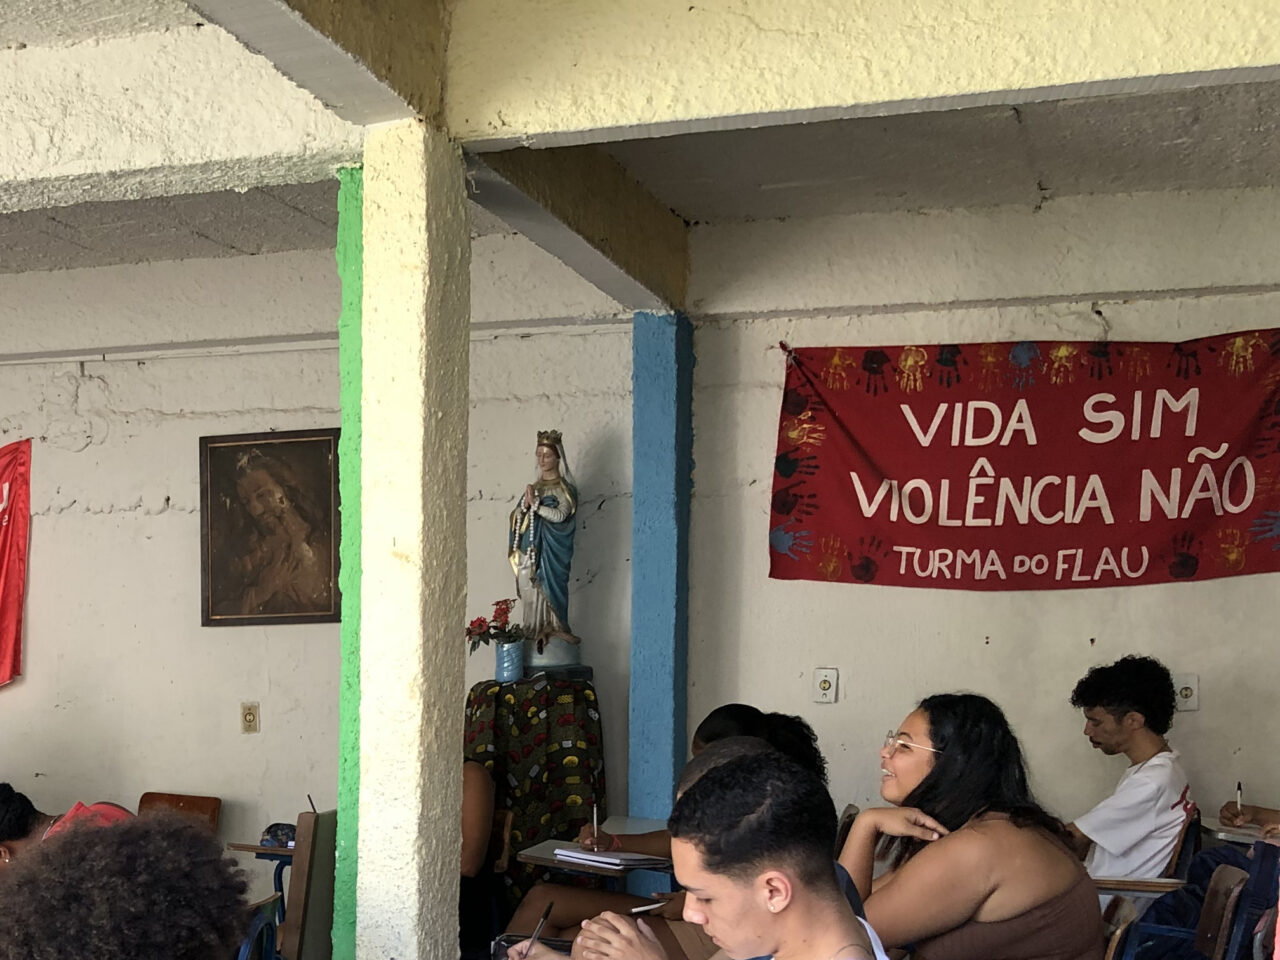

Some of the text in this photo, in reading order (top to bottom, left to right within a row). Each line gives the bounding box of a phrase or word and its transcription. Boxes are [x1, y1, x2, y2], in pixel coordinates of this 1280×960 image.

[900, 387, 1200, 447] VIDA SIM
[849, 443, 1256, 527] VIOLÊNCIA NÃO
[1, 514, 9, 526] e
[893, 545, 1007, 580] TURMA
[1054, 545, 1150, 581] FLAU
